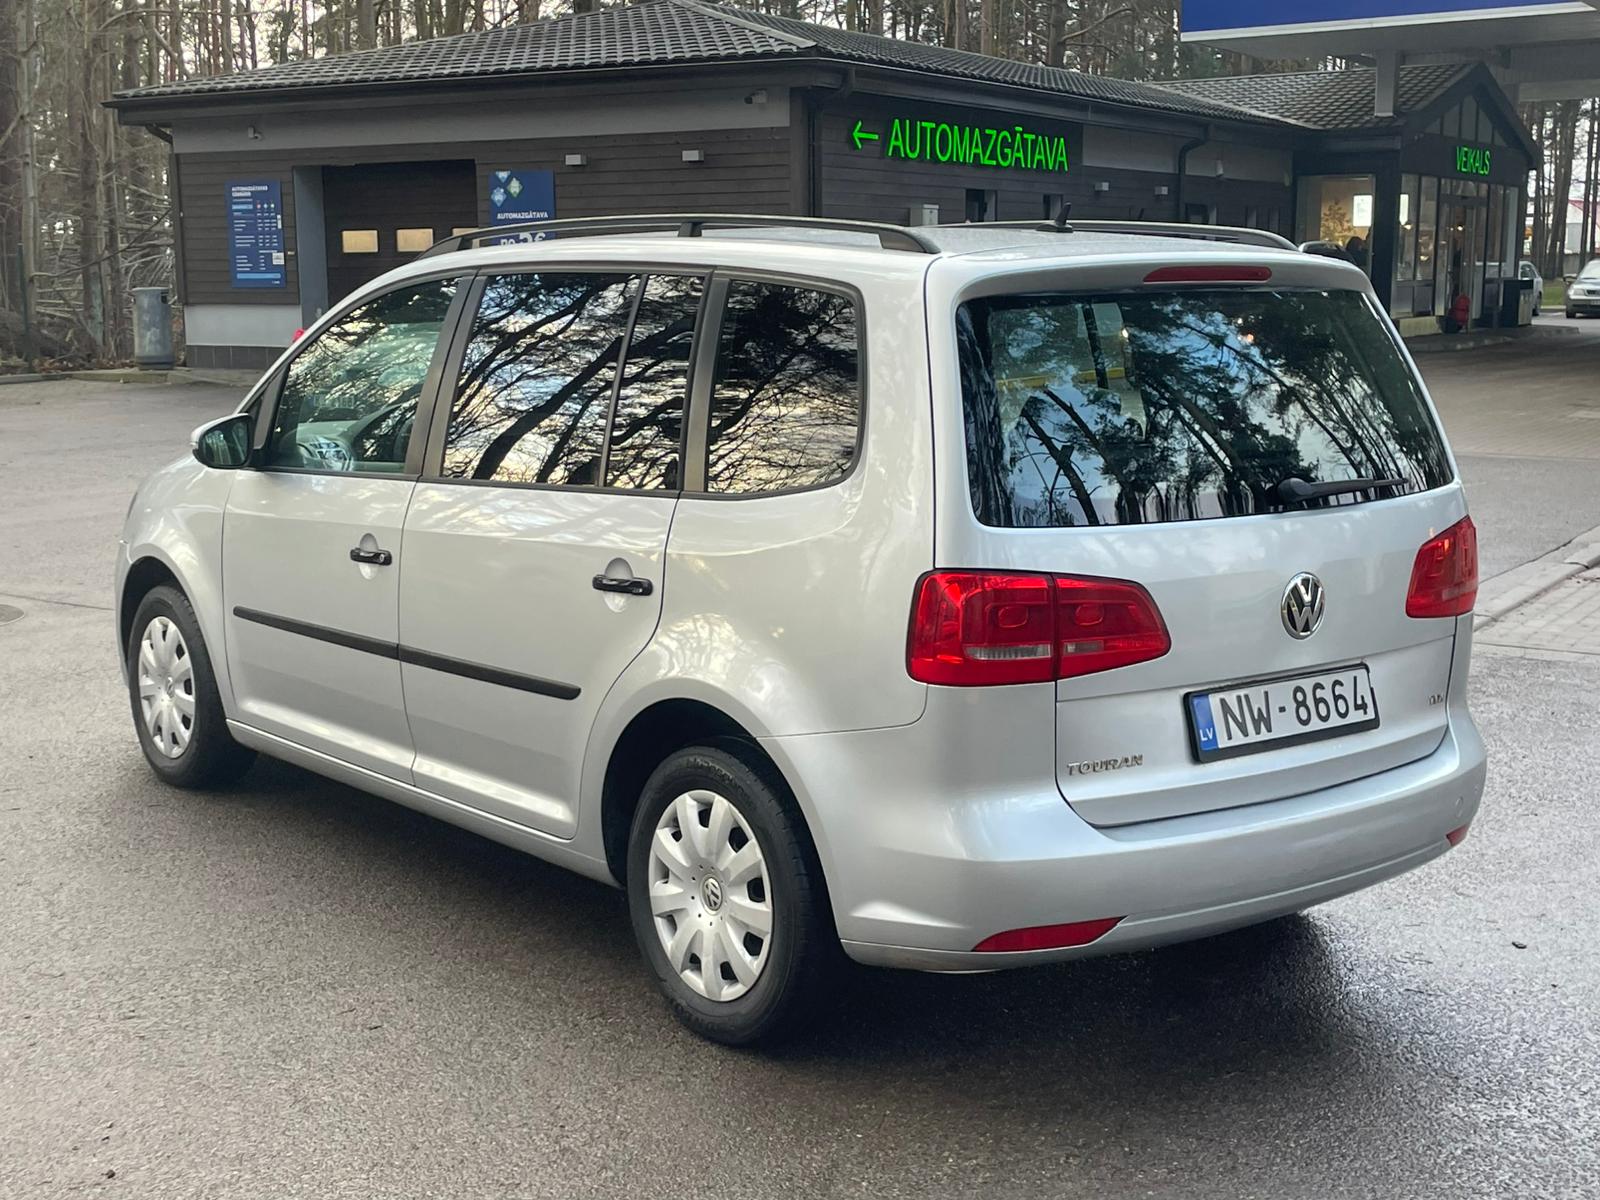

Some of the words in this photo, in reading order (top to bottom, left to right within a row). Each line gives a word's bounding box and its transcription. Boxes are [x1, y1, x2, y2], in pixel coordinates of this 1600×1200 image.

[888, 118, 1068, 172] AUTOMAZGĀTAVA
[1456, 146, 1491, 175] VEIKALS
[497, 211, 548, 219] AUTOMAZGĀTAVA
[1219, 676, 1368, 740] NW-8664
[1200, 728, 1213, 741] LV
[1067, 754, 1143, 776] TOURAN
